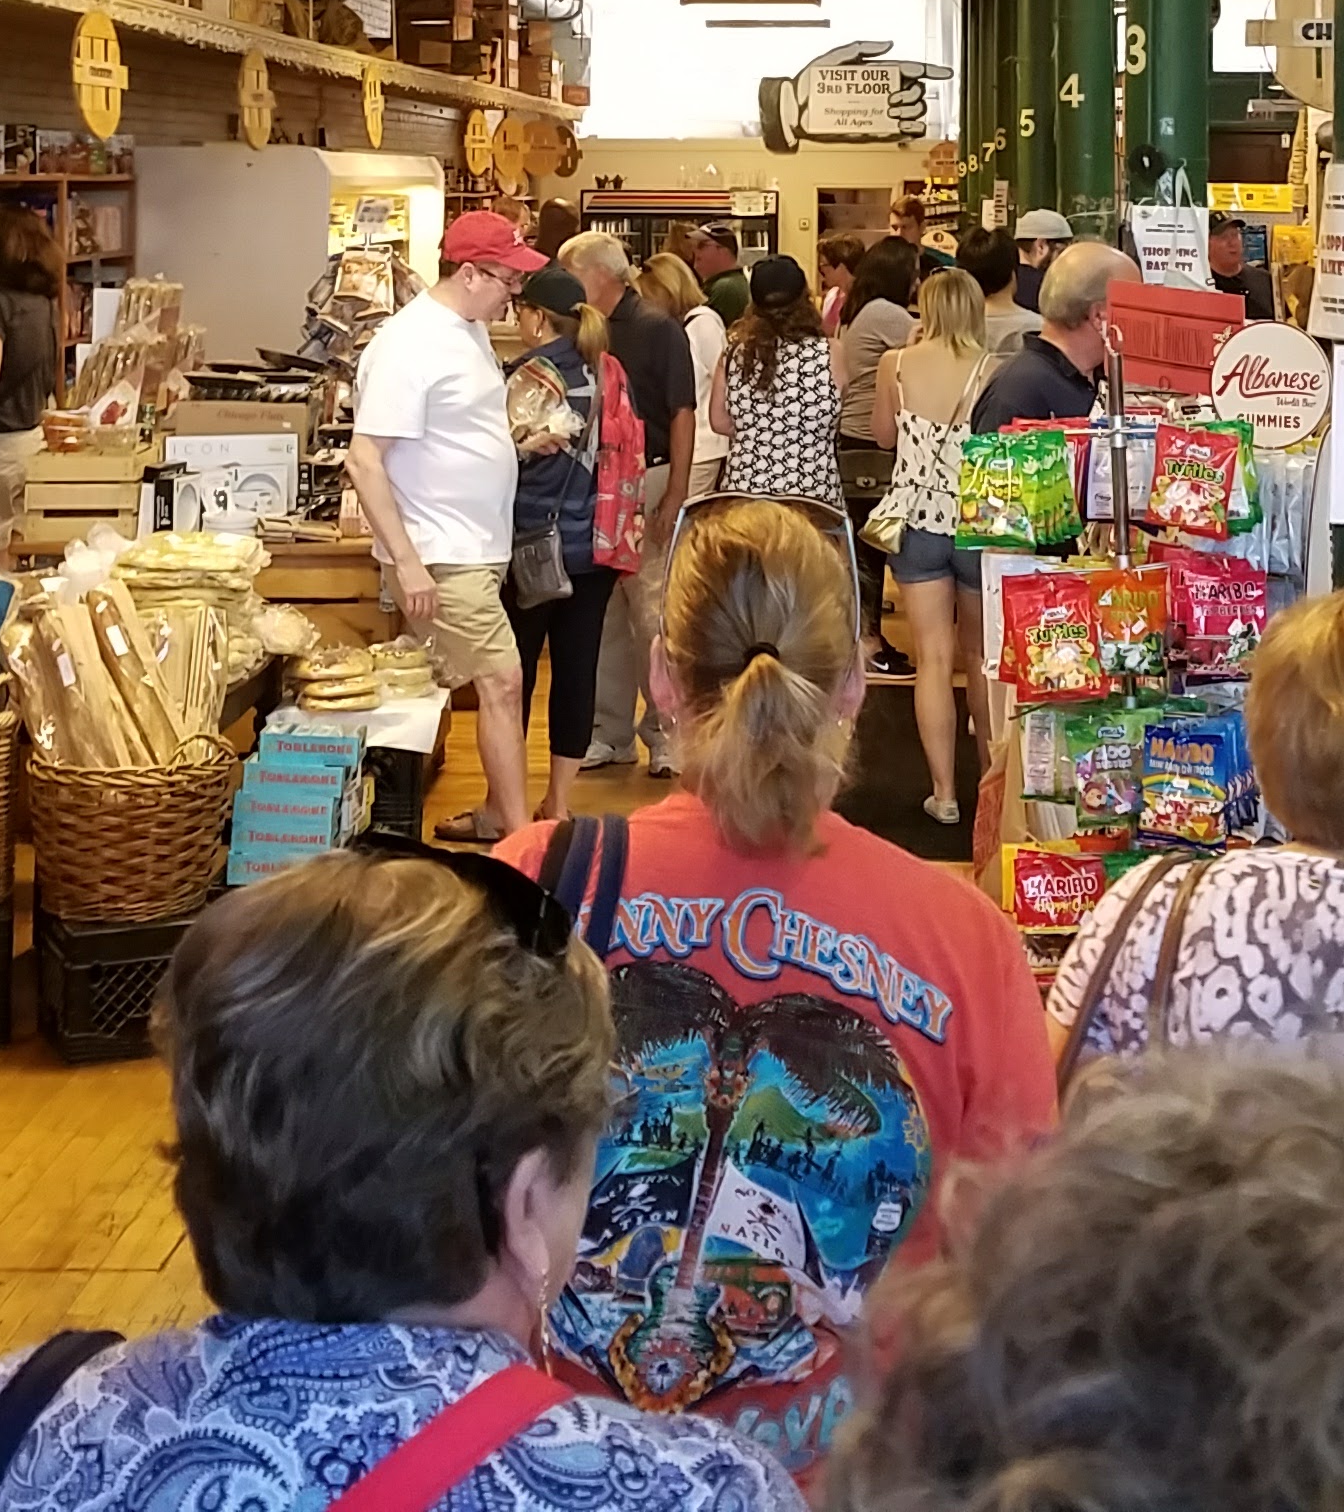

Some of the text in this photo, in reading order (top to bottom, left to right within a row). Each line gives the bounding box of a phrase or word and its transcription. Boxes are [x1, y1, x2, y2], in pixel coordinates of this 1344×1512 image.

[1301, 23, 1333, 41] CH
[1125, 24, 1147, 76] 3
[818, 69, 890, 82] VISIT OUR
[816, 82, 892, 95] 3RD FLOOR
[1059, 73, 1085, 108] 4
[823, 106, 885, 118] Shopping for
[834, 117, 874, 128] All Ages
[1018, 108, 1036, 138] 5
[994, 127, 1006, 151] 6
[982, 142, 995, 162] 7
[957, 161, 967, 178] 9
[968, 154, 978, 172] 8
[1216, 354, 1323, 397] Albanese
[172, 441, 231, 456] ICON
[1164, 458, 1225, 484] Turtles
[1194, 581, 1256, 601] HARIBO
[276, 740, 353, 754] TOBLERONE
[259, 770, 337, 785] TOBLERONE
[248, 830, 326, 845] TOBLERONE
[1023, 874, 1098, 897] HARIBO
[609, 887, 954, 1044] NNY CHESNEY
